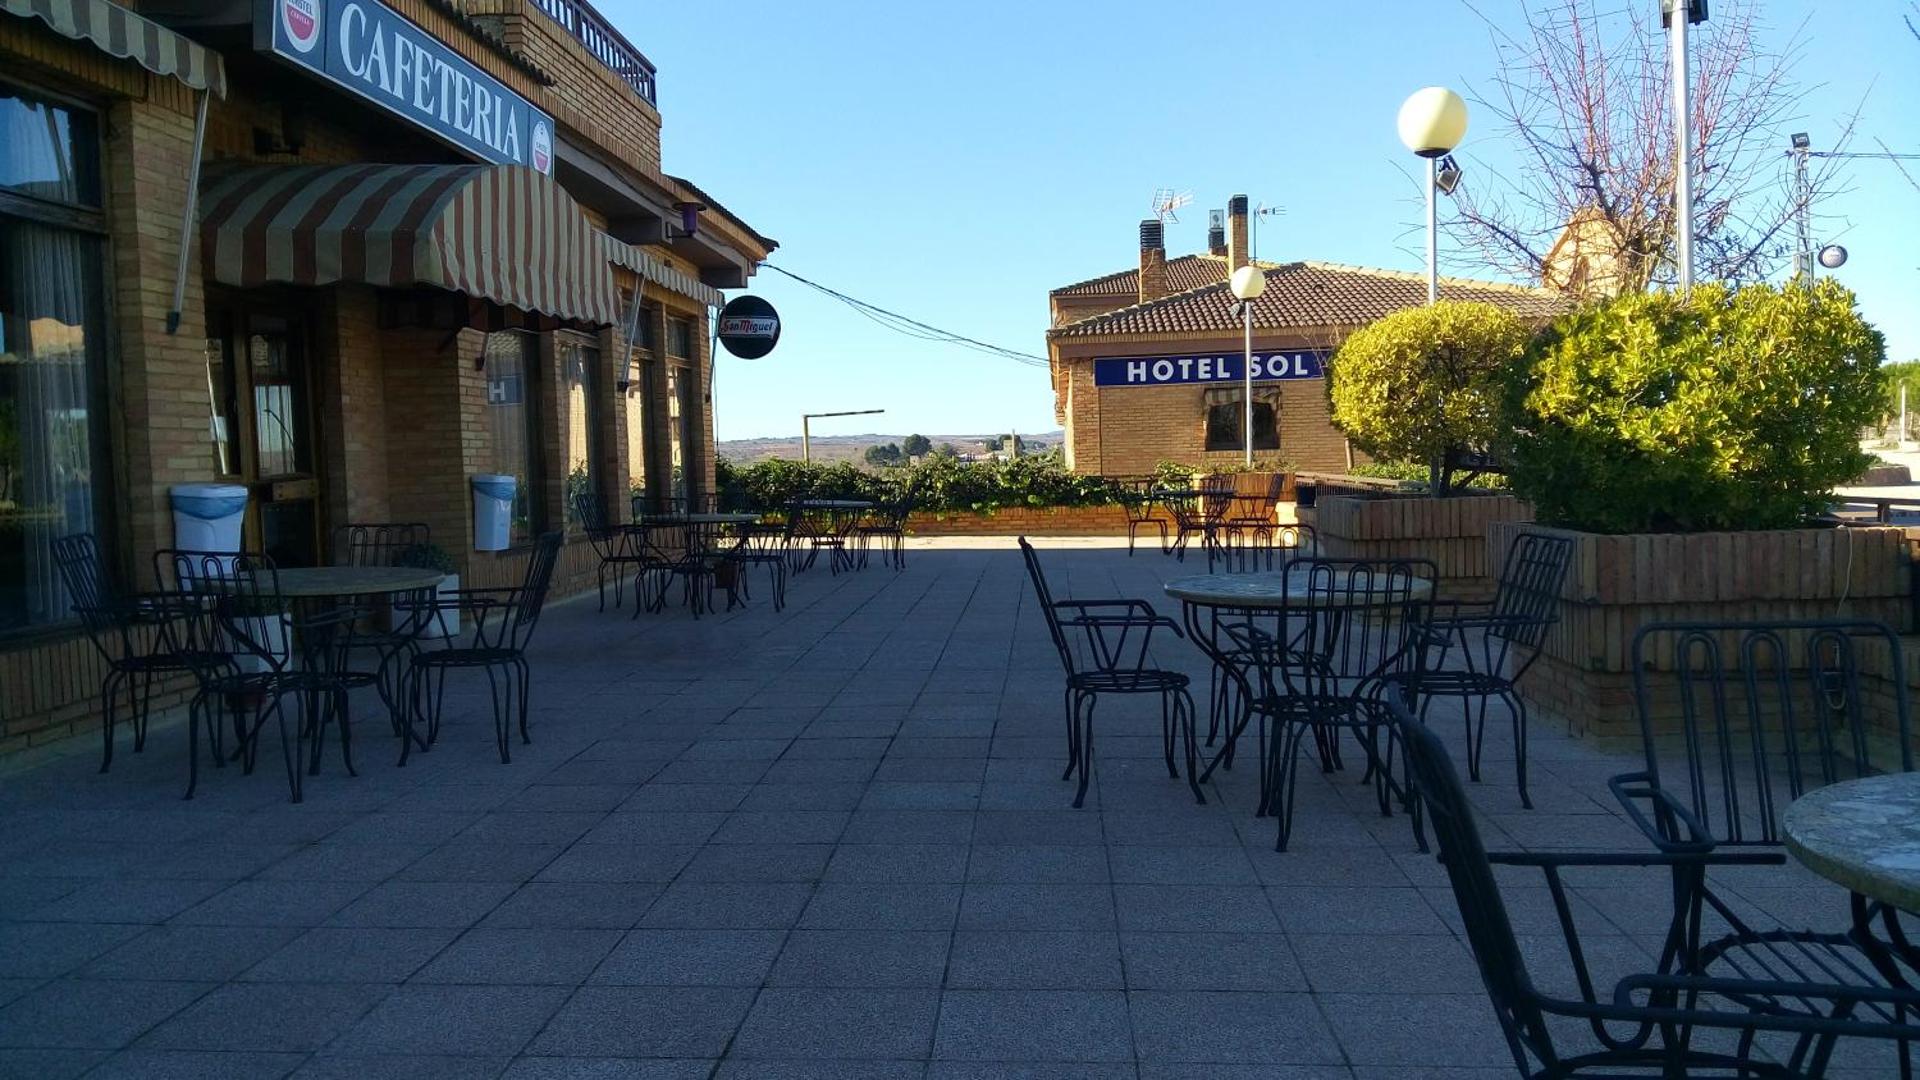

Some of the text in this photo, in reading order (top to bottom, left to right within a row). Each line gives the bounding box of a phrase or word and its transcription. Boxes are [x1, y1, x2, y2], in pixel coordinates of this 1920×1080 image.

[340, 3, 522, 163] CAFETERIA
[1127, 354, 1308, 382] HOTEL SOL
